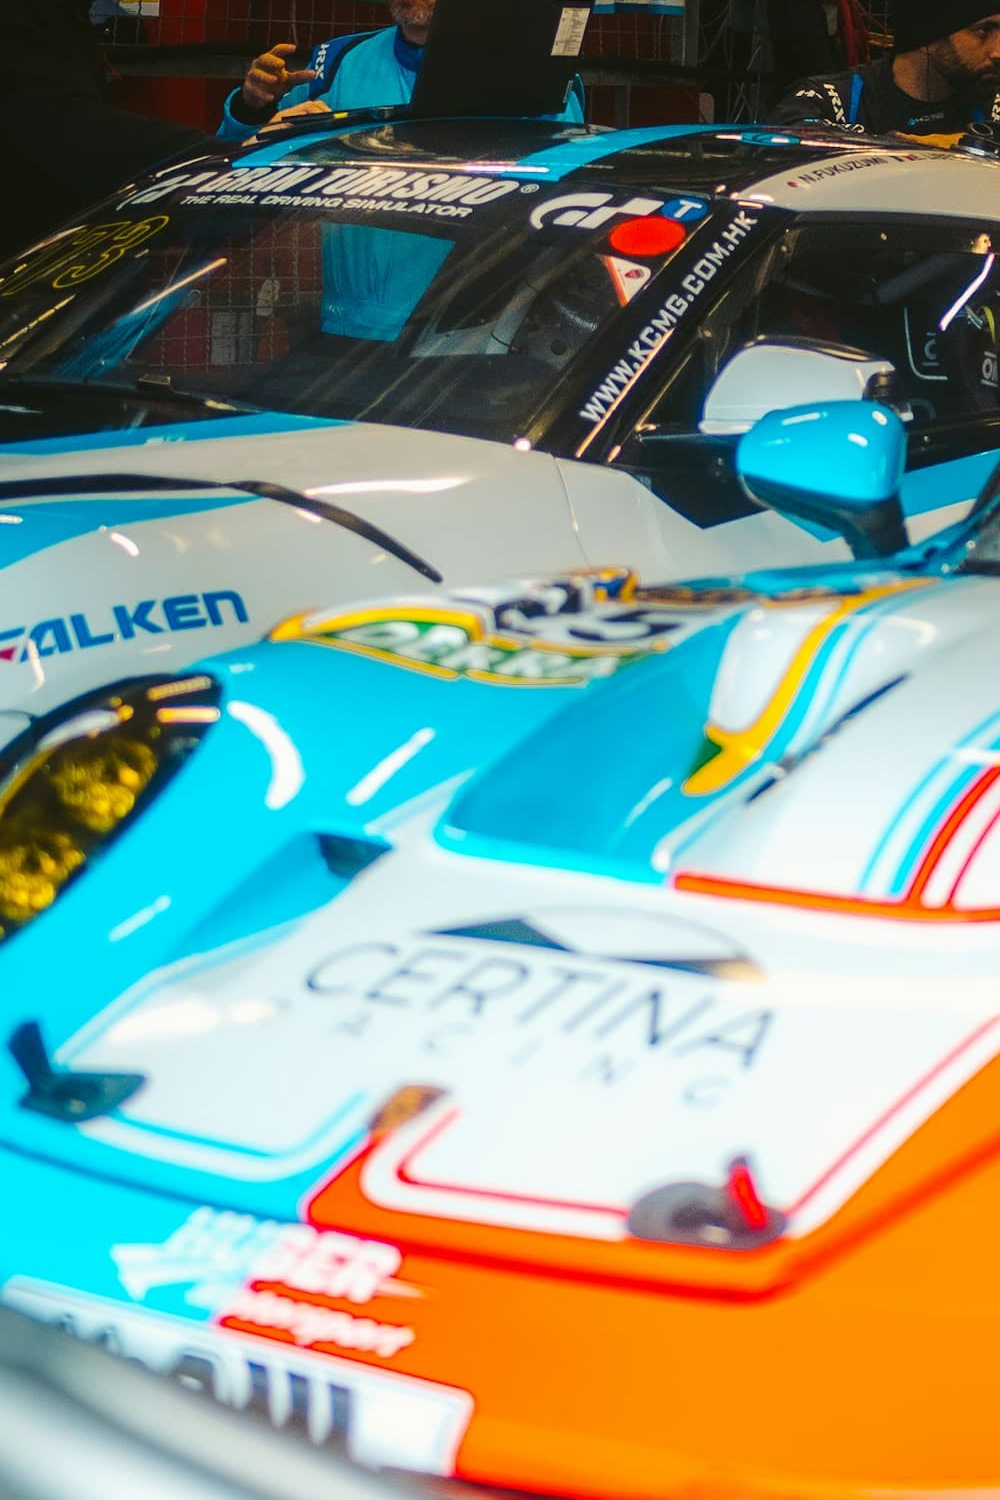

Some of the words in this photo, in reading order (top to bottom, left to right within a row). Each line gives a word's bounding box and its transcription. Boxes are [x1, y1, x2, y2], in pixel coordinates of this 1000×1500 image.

[823, 83, 846, 124] HRX
[180, 194, 212, 205] THE
[213, 194, 258, 205] REAL
[260, 196, 344, 209] DRIVING
[343, 198, 473, 218] SIMULATOR
[196, 167, 324, 193] GRAN
[301, 168, 520, 205] TURISMO
[578, 210, 759, 422] WWW.KCMG.COM.HK
[304, 941, 775, 1073] CERTINA
